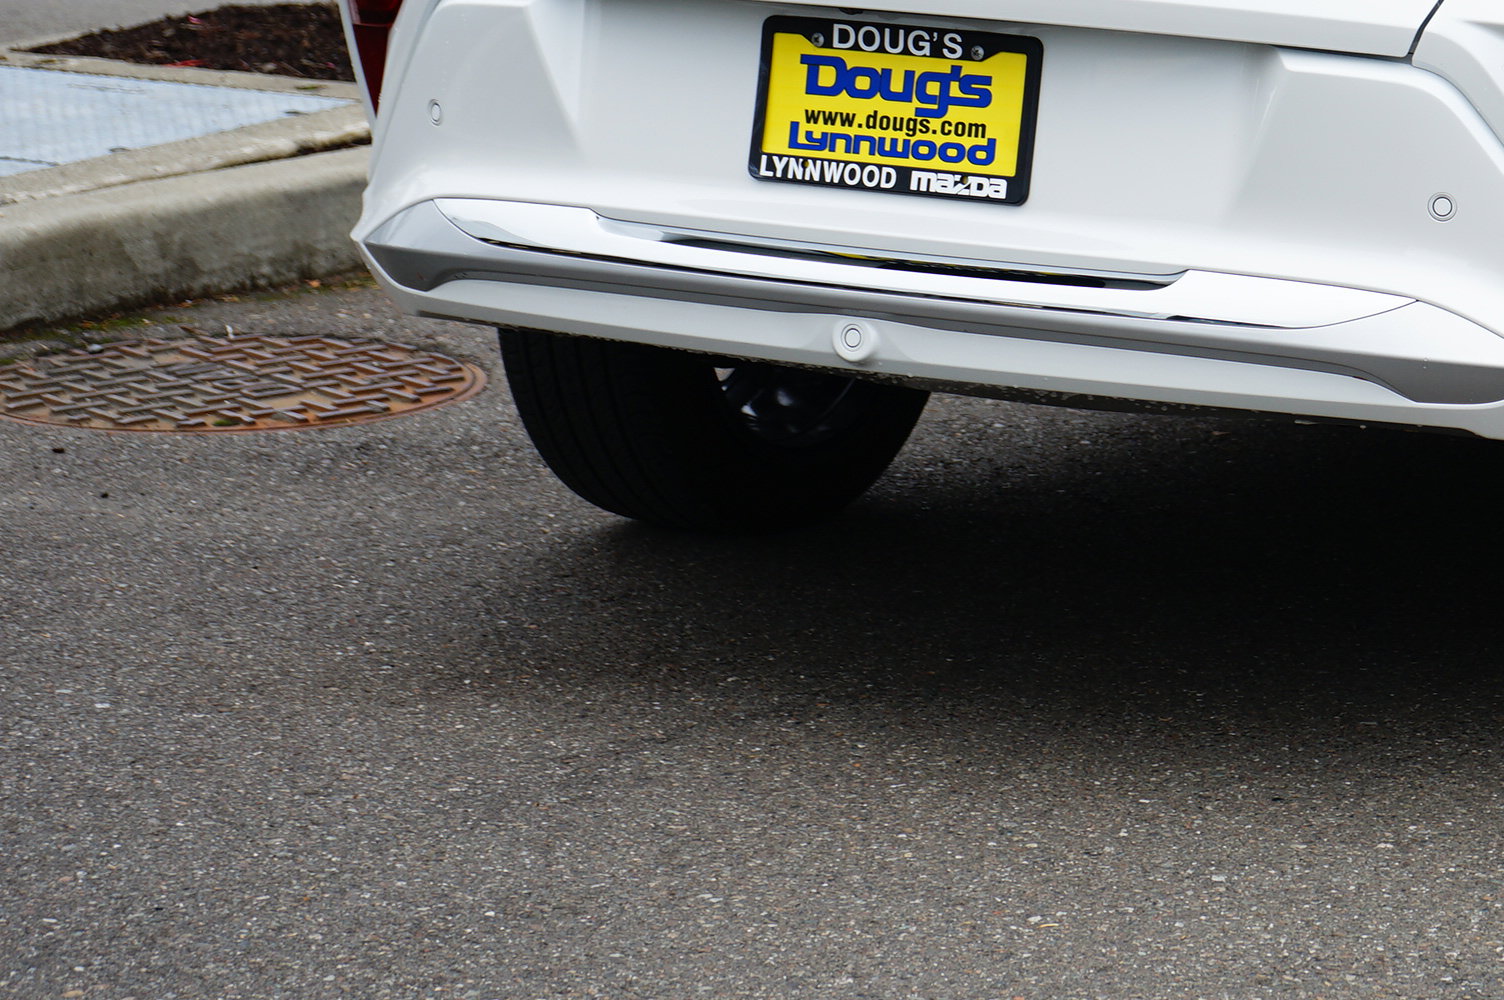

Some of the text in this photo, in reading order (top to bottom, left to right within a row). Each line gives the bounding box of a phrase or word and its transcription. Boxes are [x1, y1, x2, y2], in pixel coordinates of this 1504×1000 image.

[832, 23, 963, 60] DOUG'S
[800, 53, 993, 119] Doug's
[804, 109, 987, 139] www.dougs.com
[788, 121, 997, 166] Lynnwood
[759, 154, 897, 190] LYNNWOOD
